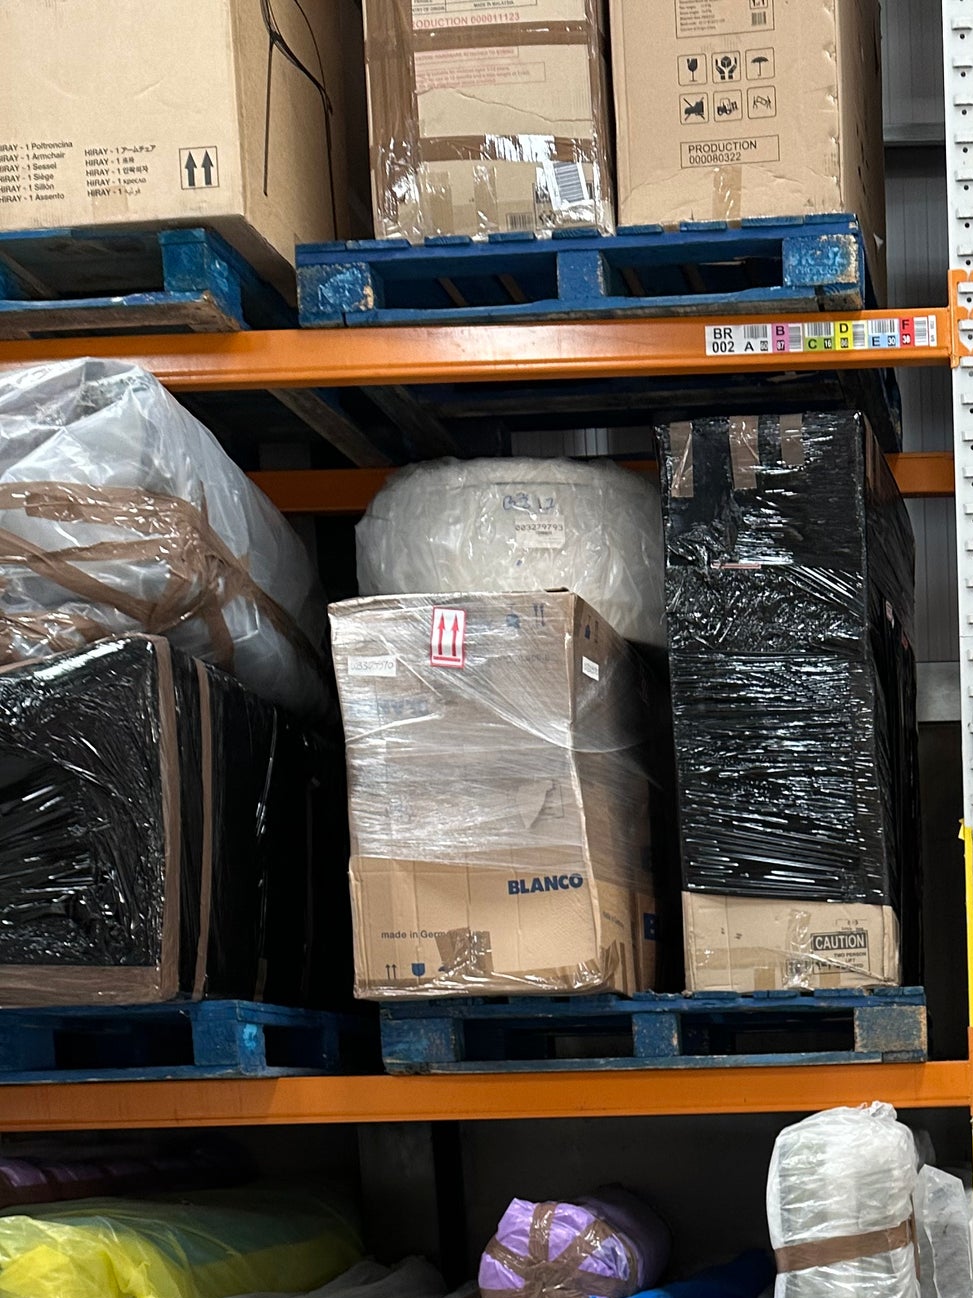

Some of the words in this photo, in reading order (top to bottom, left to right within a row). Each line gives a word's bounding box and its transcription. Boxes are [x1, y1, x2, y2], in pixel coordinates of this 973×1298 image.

[413, 16, 468, 29] ODUCTION
[688, 140, 757, 154] PRODUCTION
[32, 152, 65, 161] Armchair
[689, 152, 741, 164] 000080322
[33, 162, 56, 171] Sessel
[840, 323, 848, 333] D
[902, 320, 909, 329] F
[713, 328, 732, 339] BR
[776, 326, 784, 336] B
[808, 339, 817, 349] C
[872, 336, 880, 346] E
[712, 341, 734, 353] 002
[744, 342, 754, 351] A
[508, 873, 583, 895] BLANCO
[381, 931, 406, 939] made
[816, 934, 864, 949] CAUTION
